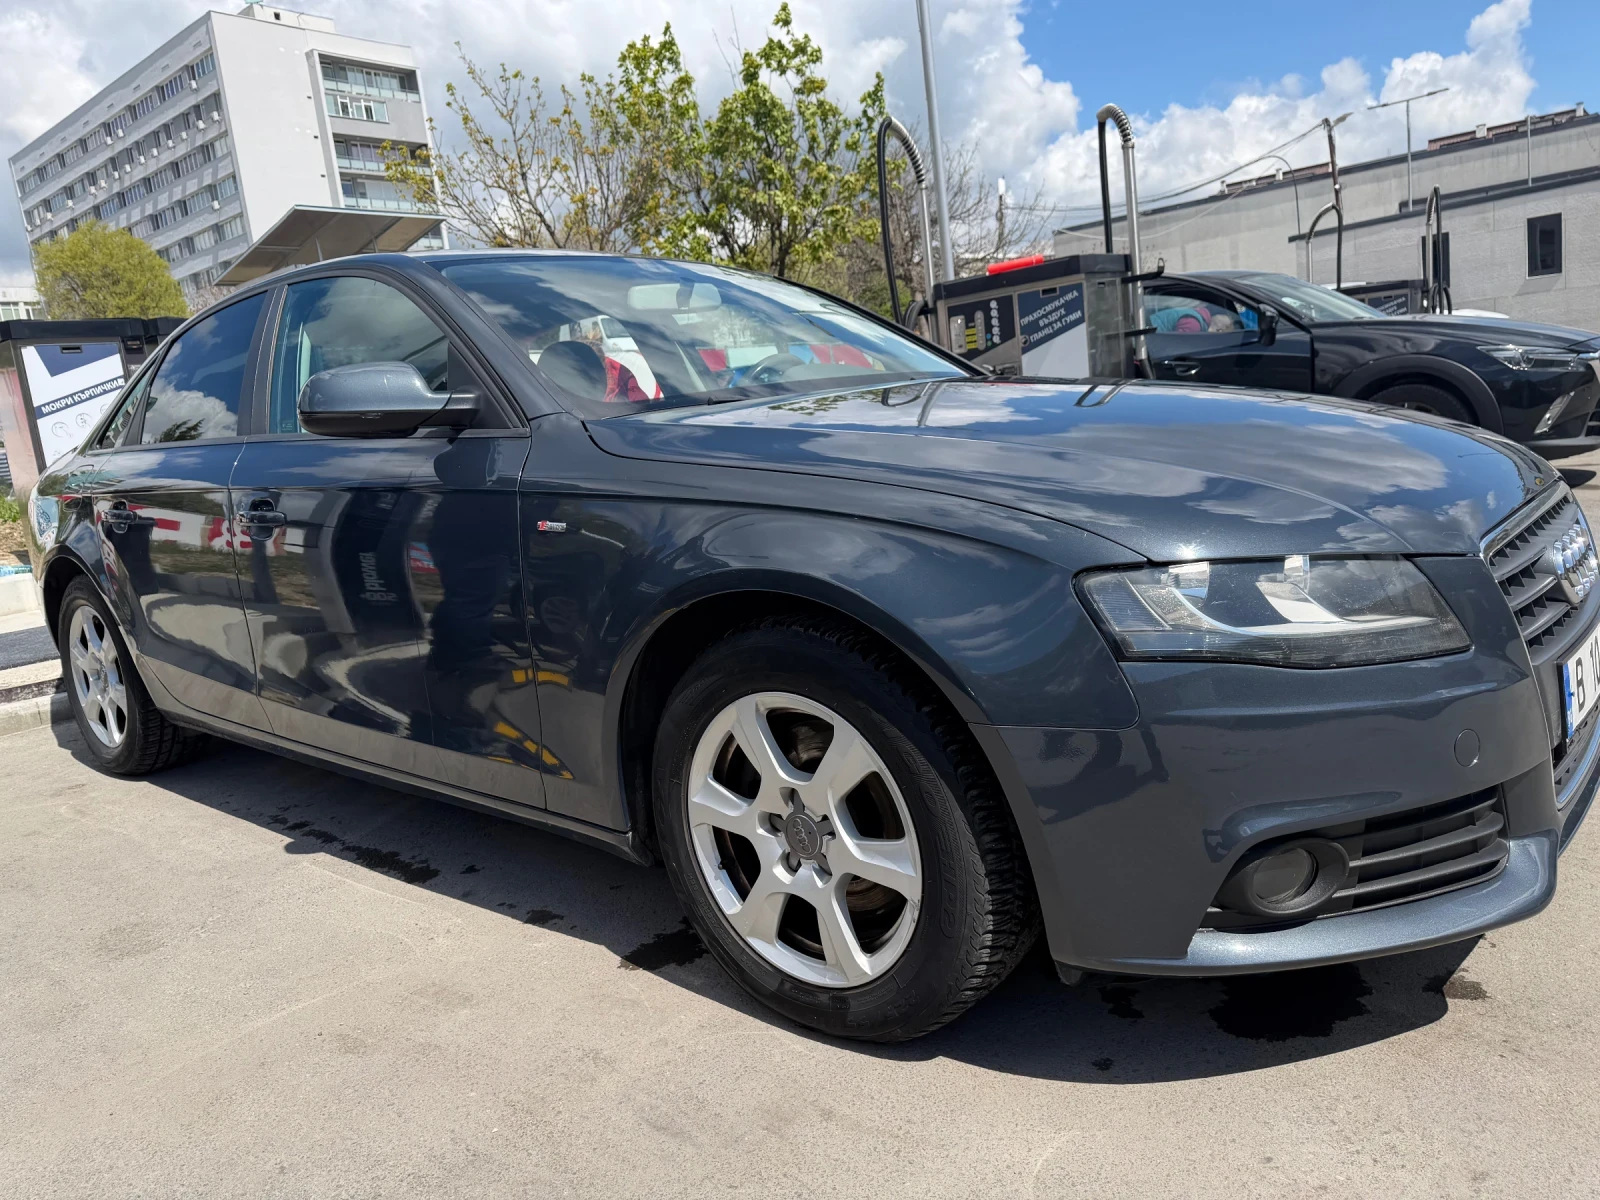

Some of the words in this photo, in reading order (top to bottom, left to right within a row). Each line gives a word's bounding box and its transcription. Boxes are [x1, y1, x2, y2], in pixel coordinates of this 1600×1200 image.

[1020, 289, 1079, 327] ПРАХОСМУКАЧКА
[1038, 307, 1066, 327] ВЪЗДУХ
[1030, 326, 1054, 343] ГЛАНЦ
[1052, 321, 1062, 331] ЗА
[1061, 310, 1082, 326] ГУМИ
[41, 397, 74, 414] МОКРИ
[74, 378, 119, 402] КЪРПИЧКИ
[1575, 656, 1586, 713] B
